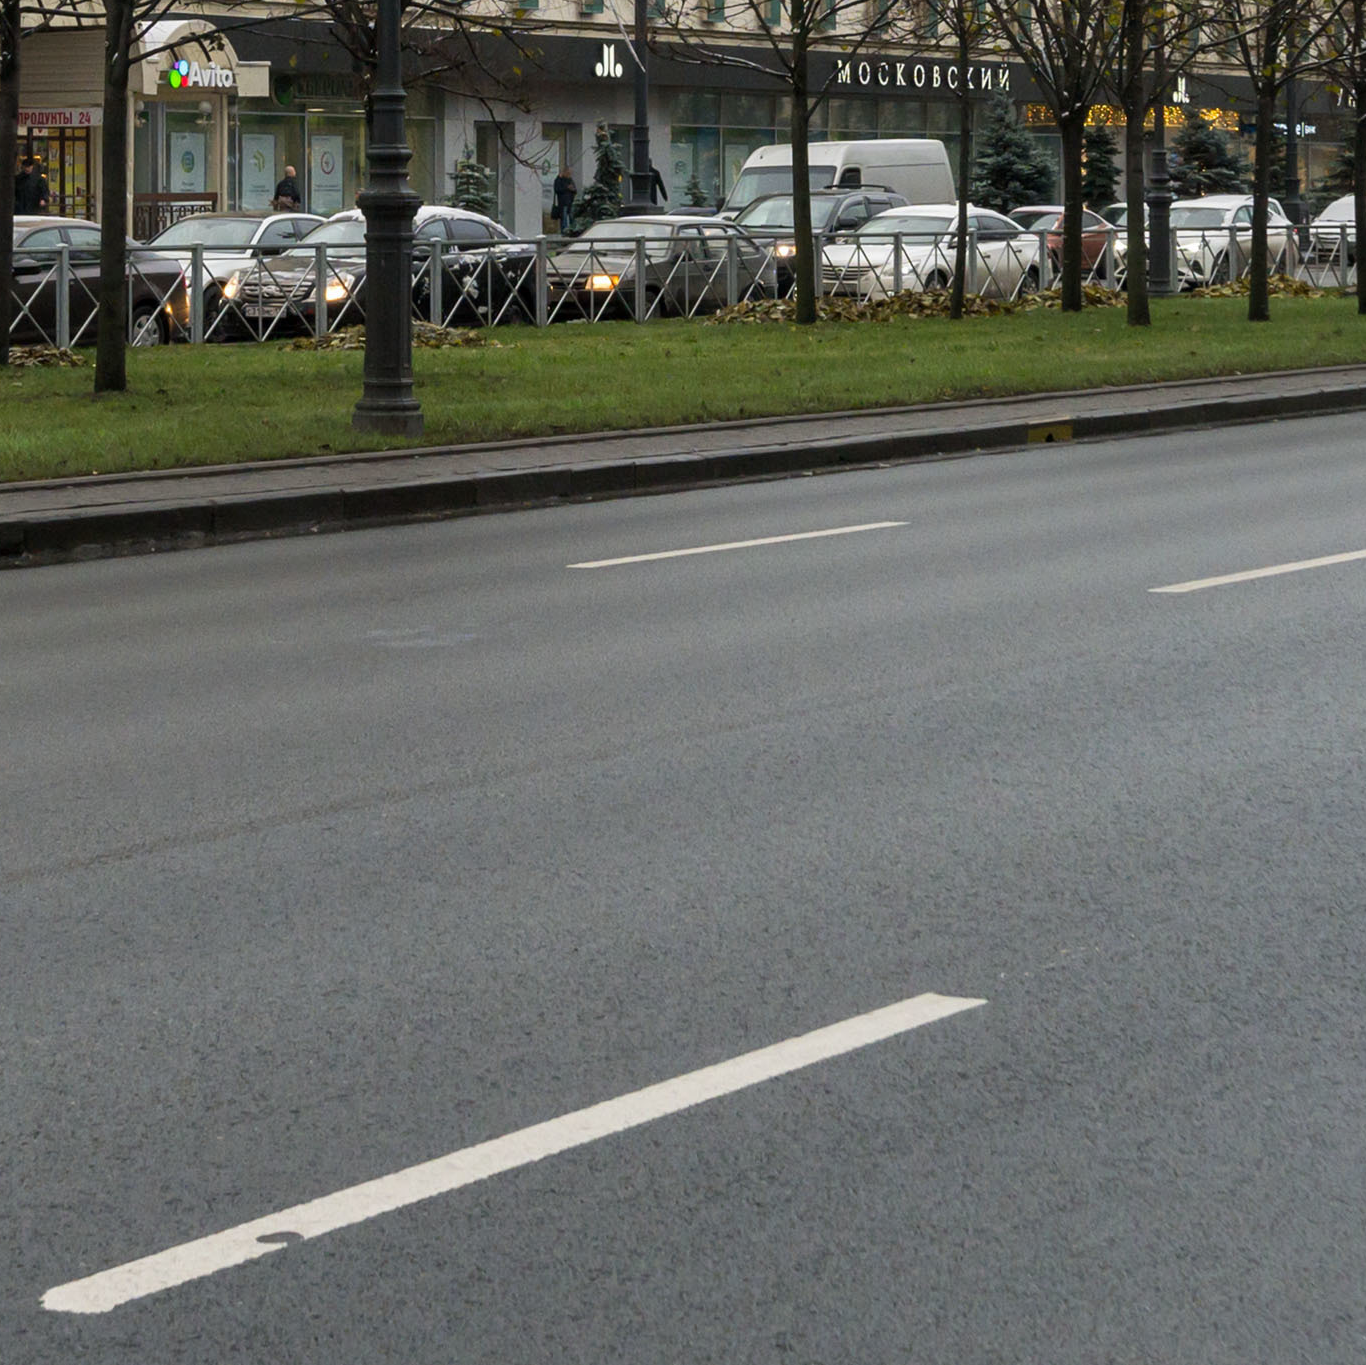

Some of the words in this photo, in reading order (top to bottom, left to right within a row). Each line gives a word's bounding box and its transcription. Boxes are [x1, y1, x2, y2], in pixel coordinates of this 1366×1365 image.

[188, 61, 233, 88] Avito
[837, 60, 1010, 91] МОСКОВСКИЙ
[78, 113, 92, 125] 24
